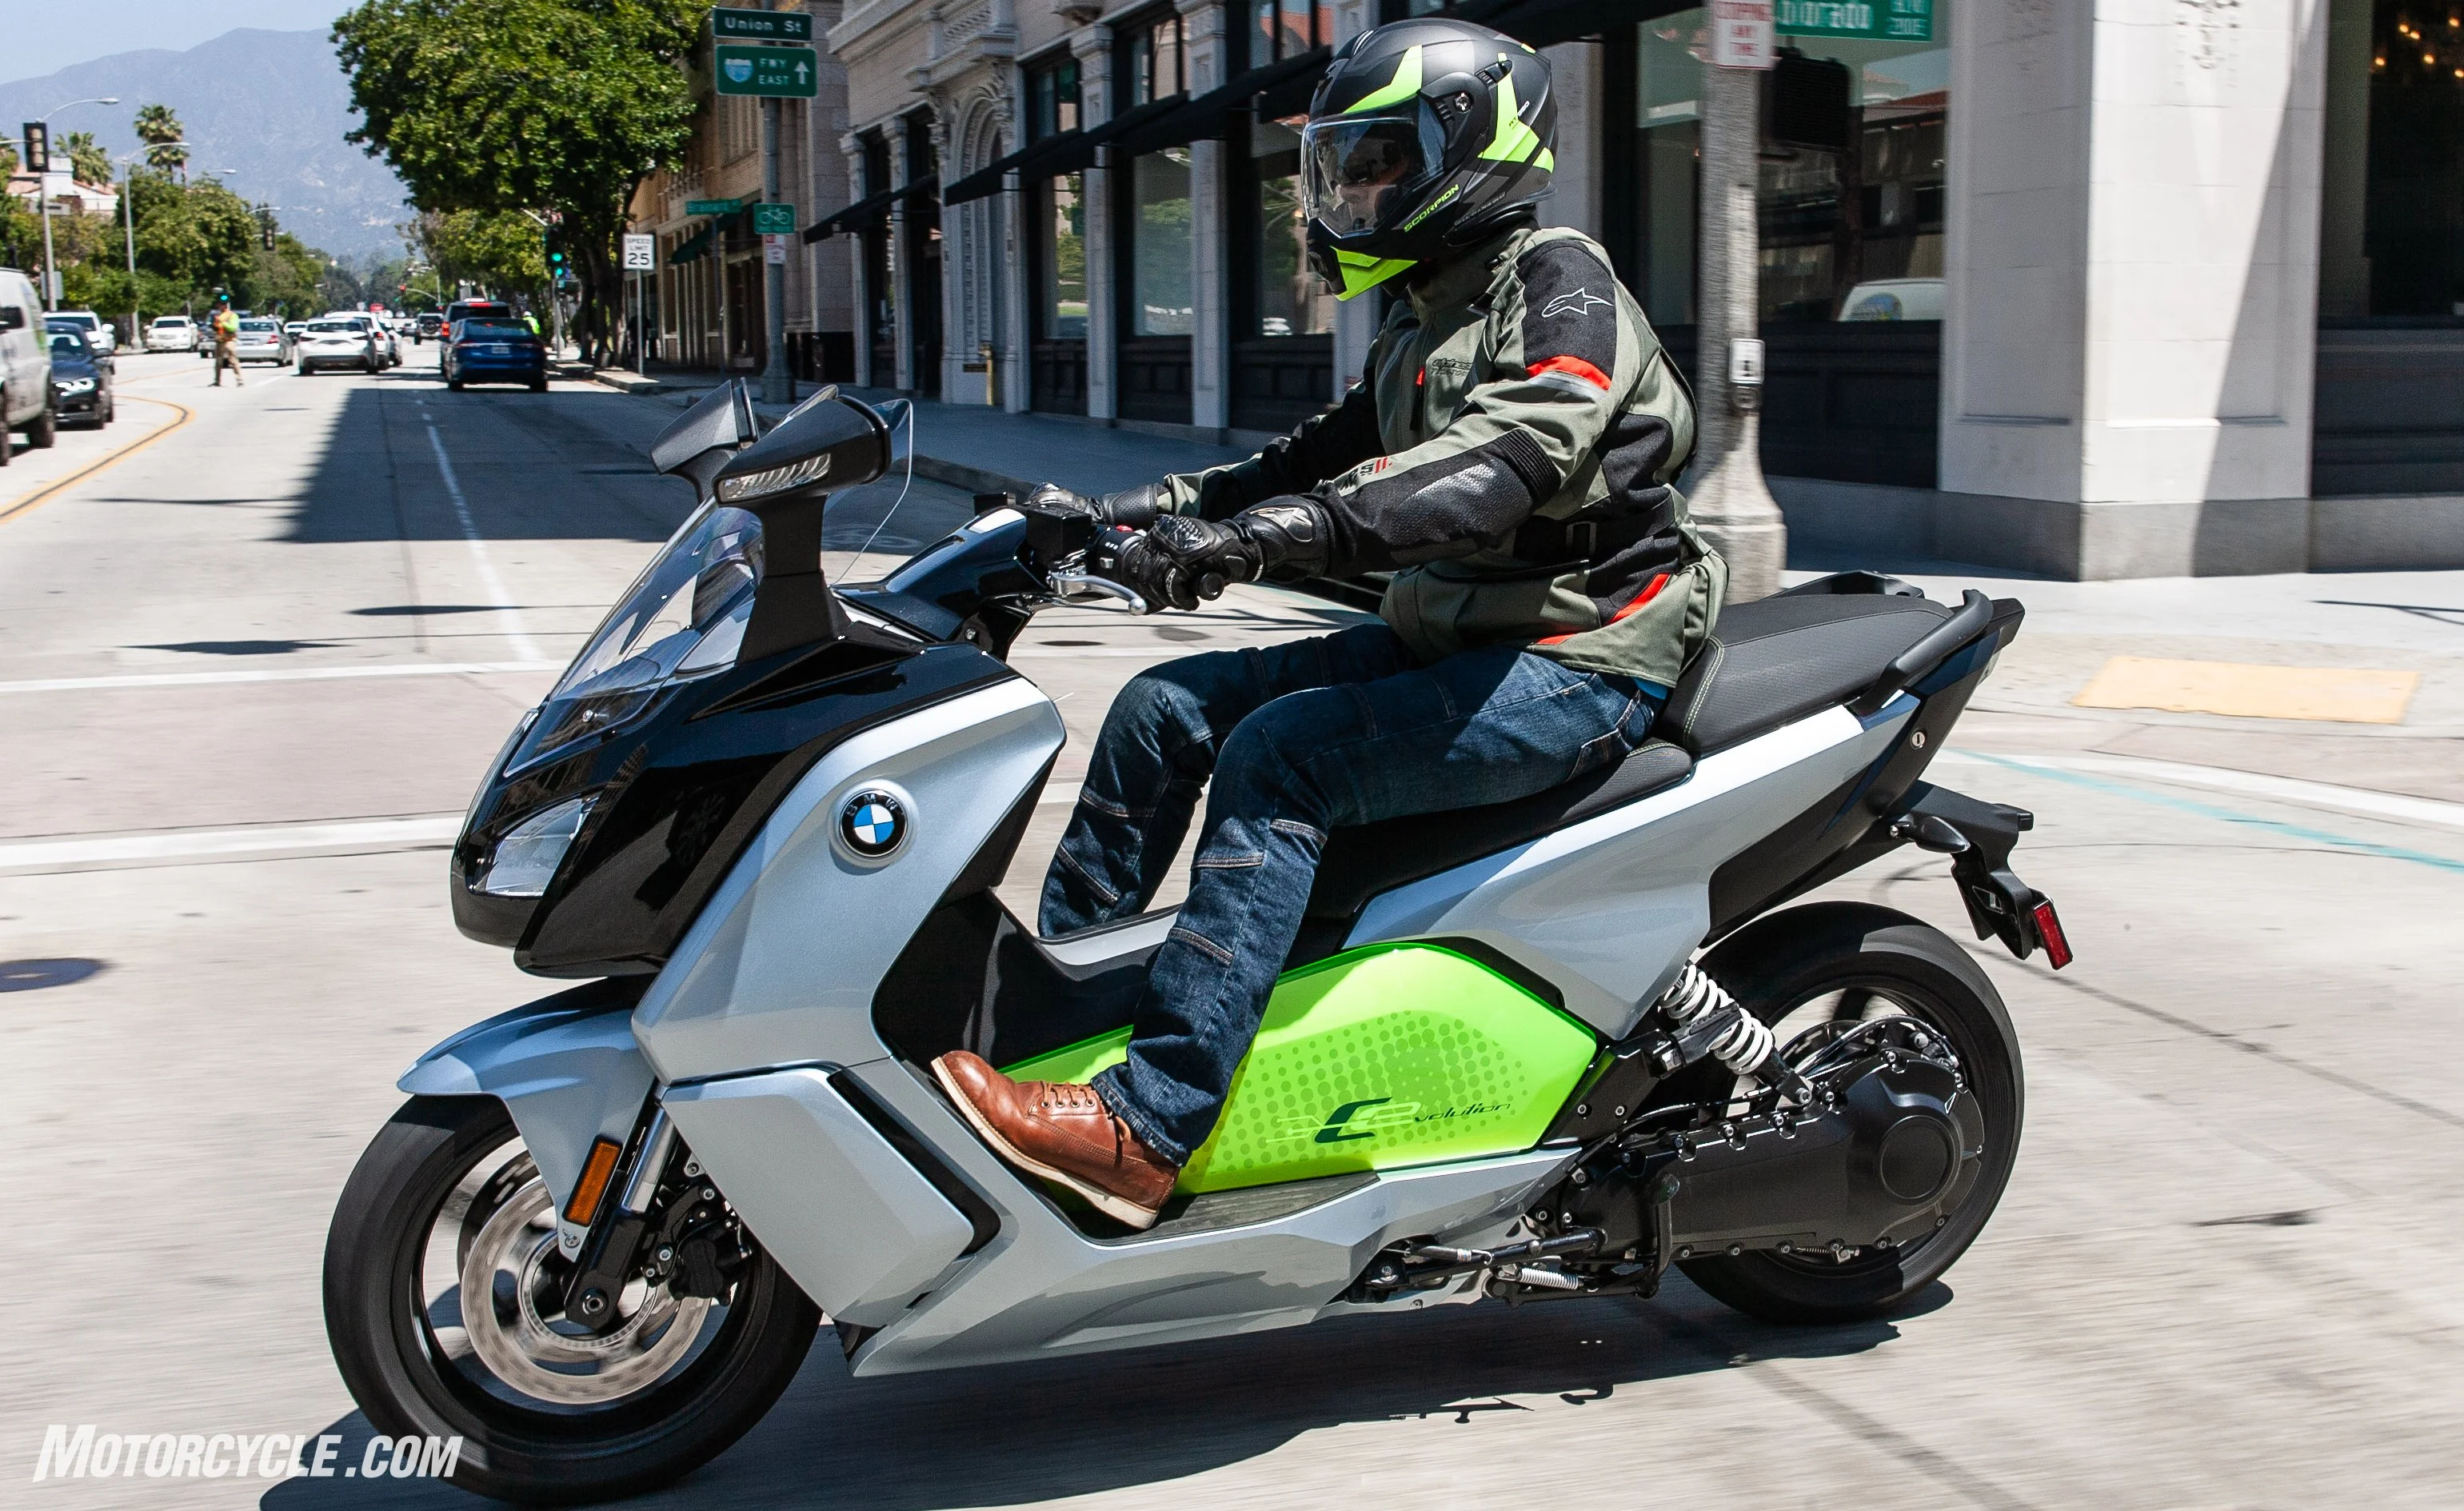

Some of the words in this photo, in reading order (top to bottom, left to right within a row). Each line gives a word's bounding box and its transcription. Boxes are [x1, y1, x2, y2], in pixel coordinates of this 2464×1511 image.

[1775, 0, 1875, 30] olorado
[724, 17, 773, 30] Union
[784, 20, 802, 33] St
[759, 58, 788, 68] FWY
[758, 75, 790, 85] EAST
[1404, 184, 1460, 233] SCORPION
[628, 252, 649, 266] 25
[846, 794, 898, 817] BMW
